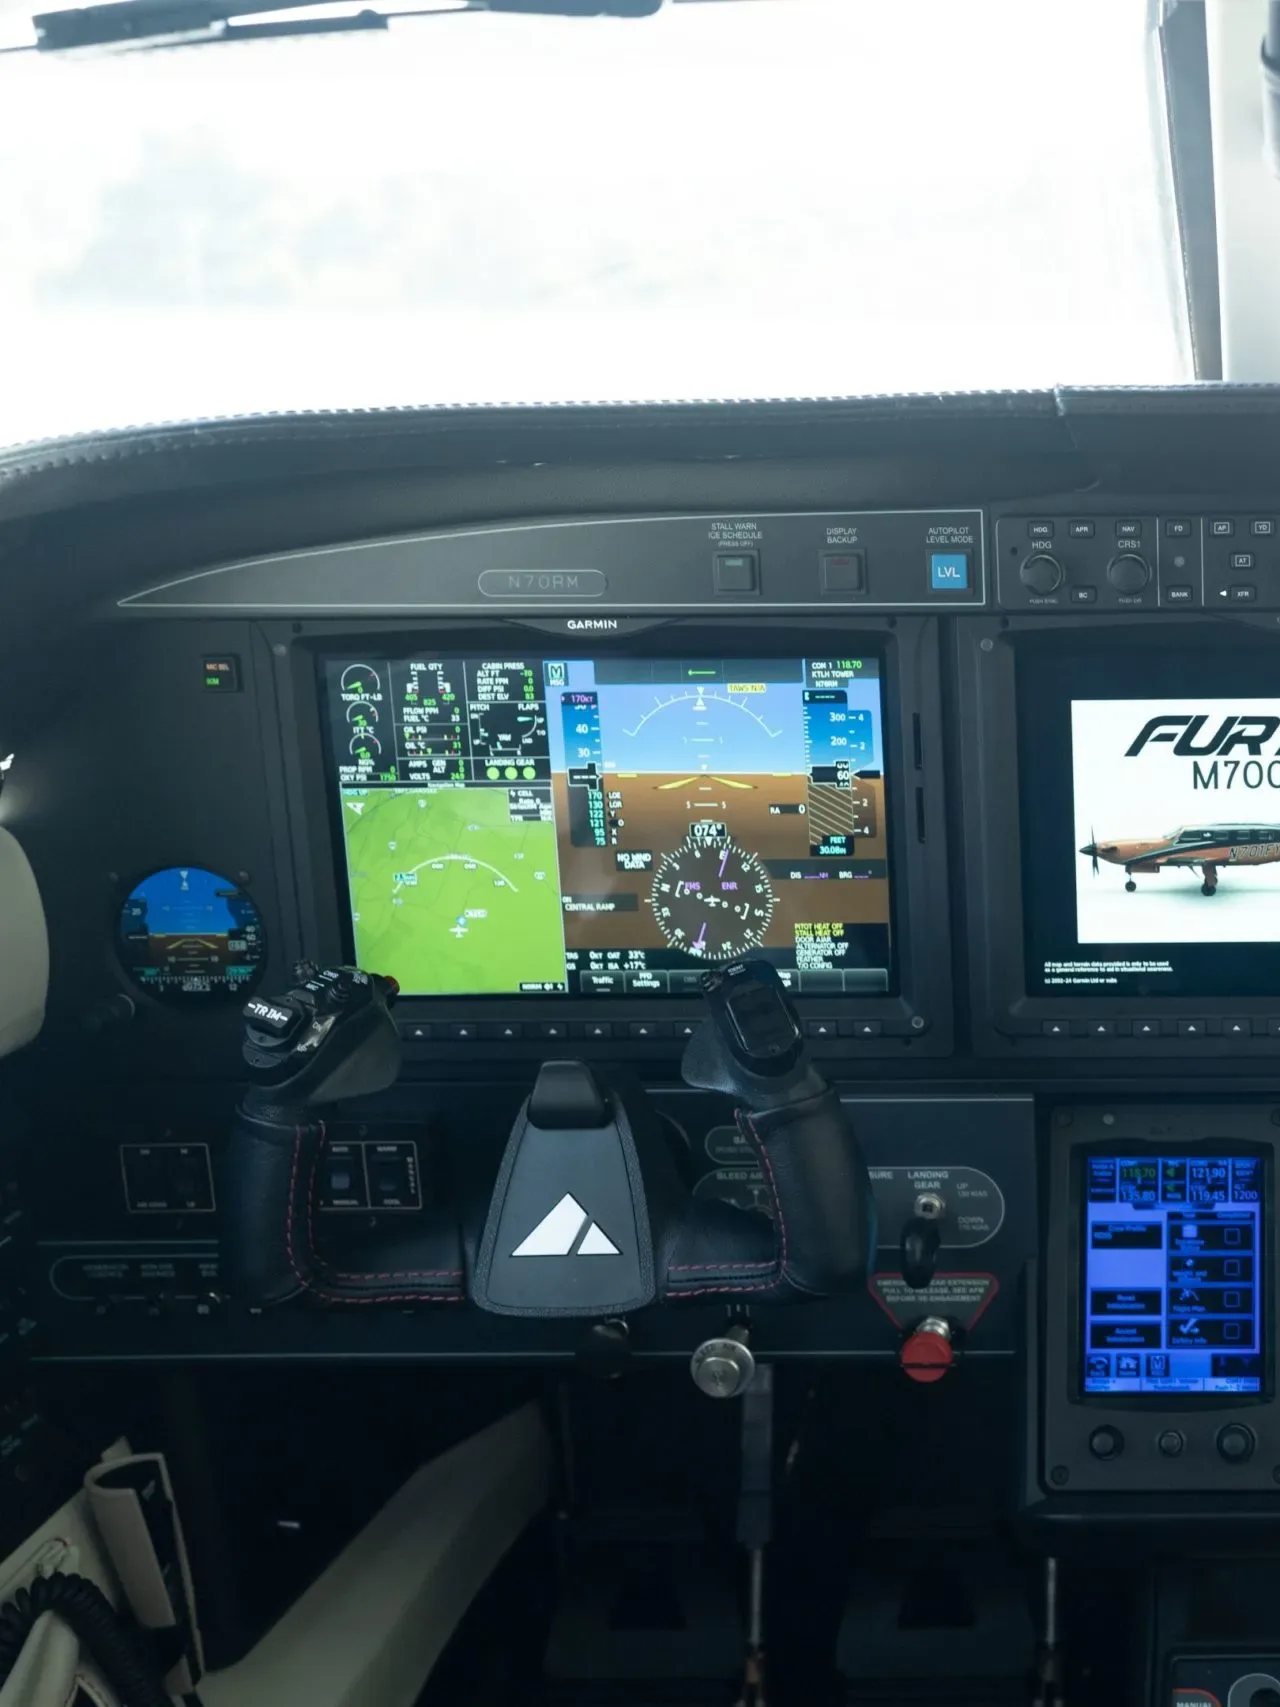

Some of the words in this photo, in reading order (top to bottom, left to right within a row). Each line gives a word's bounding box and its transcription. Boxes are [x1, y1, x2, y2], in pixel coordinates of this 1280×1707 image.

[712, 522, 732, 531] STALL
[734, 522, 757, 531] WARN
[708, 532, 721, 540] ICE
[722, 532, 762, 540] SCHEDULE
[826, 528, 857, 536] DISPLAY
[928, 527, 969, 536] AUTOPILOT
[827, 536, 858, 544] BACKUP
[926, 536, 949, 544] LEVEL
[950, 536, 973, 544] MODE
[1118, 540, 1141, 549] CRS1
[1032, 541, 1052, 550] HDG
[937, 566, 960, 578] LVL
[567, 620, 617, 630] GARMIN
[836, 660, 862, 670] 118.70
[254, 1004, 282, 1020] TRIM
[907, 1171, 948, 1179] LANDING
[1192, 1168, 1226, 1178] 121.90
[914, 1181, 941, 1189] GEAR
[1192, 1191, 1225, 1201] 119.45
